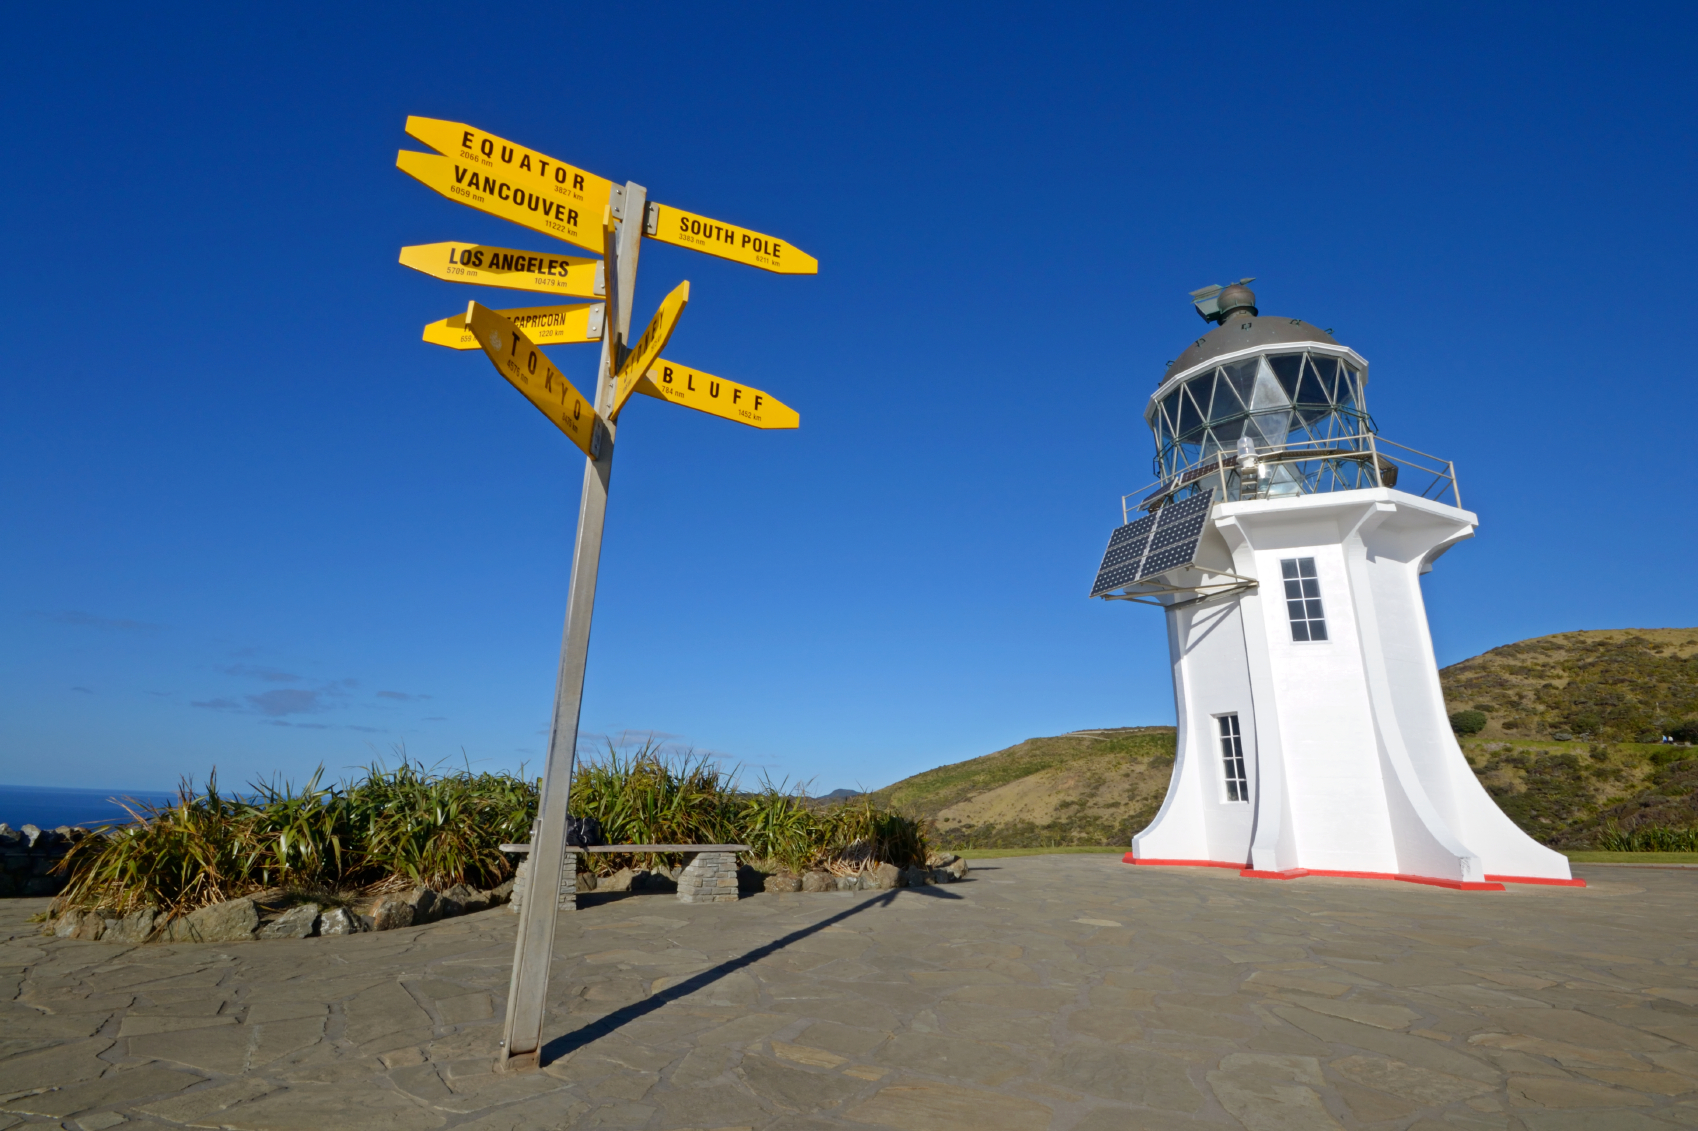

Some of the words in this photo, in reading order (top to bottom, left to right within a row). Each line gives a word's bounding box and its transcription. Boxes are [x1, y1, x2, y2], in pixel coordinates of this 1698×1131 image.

[459, 150, 480, 164] 2066
[481, 157, 493, 168] nm
[461, 130, 585, 192] EQUATOR
[450, 184, 470, 199] 6059
[472, 192, 485, 203] nm
[453, 164, 579, 228] VANCOUVER
[553, 185, 572, 198] 3827
[573, 190, 584, 202] km
[545, 220, 566, 233] 11222
[567, 226, 578, 237] km
[679, 216, 735, 245] SOUTH
[741, 233, 781, 258] POLE
[679, 233, 694, 243] 3383
[695, 238, 706, 246] nm
[446, 266, 465, 275] 5709
[449, 247, 485, 267] LOS
[488, 252, 570, 277] ANGELES
[772, 259, 780, 267] km
[534, 277, 555, 286] 10479
[556, 280, 568, 288] km
[513, 312, 567, 329] CAPRICORN
[538, 330, 553, 338] 1220
[511, 330, 581, 421] TOKYO
[520, 373, 529, 385] nm
[661, 385, 673, 395] 784
[674, 390, 685, 399] nm
[662, 366, 763, 411] BLUFF
[738, 409, 752, 419] 1452
[753, 414, 762, 422] km
[572, 422, 578, 434] km
